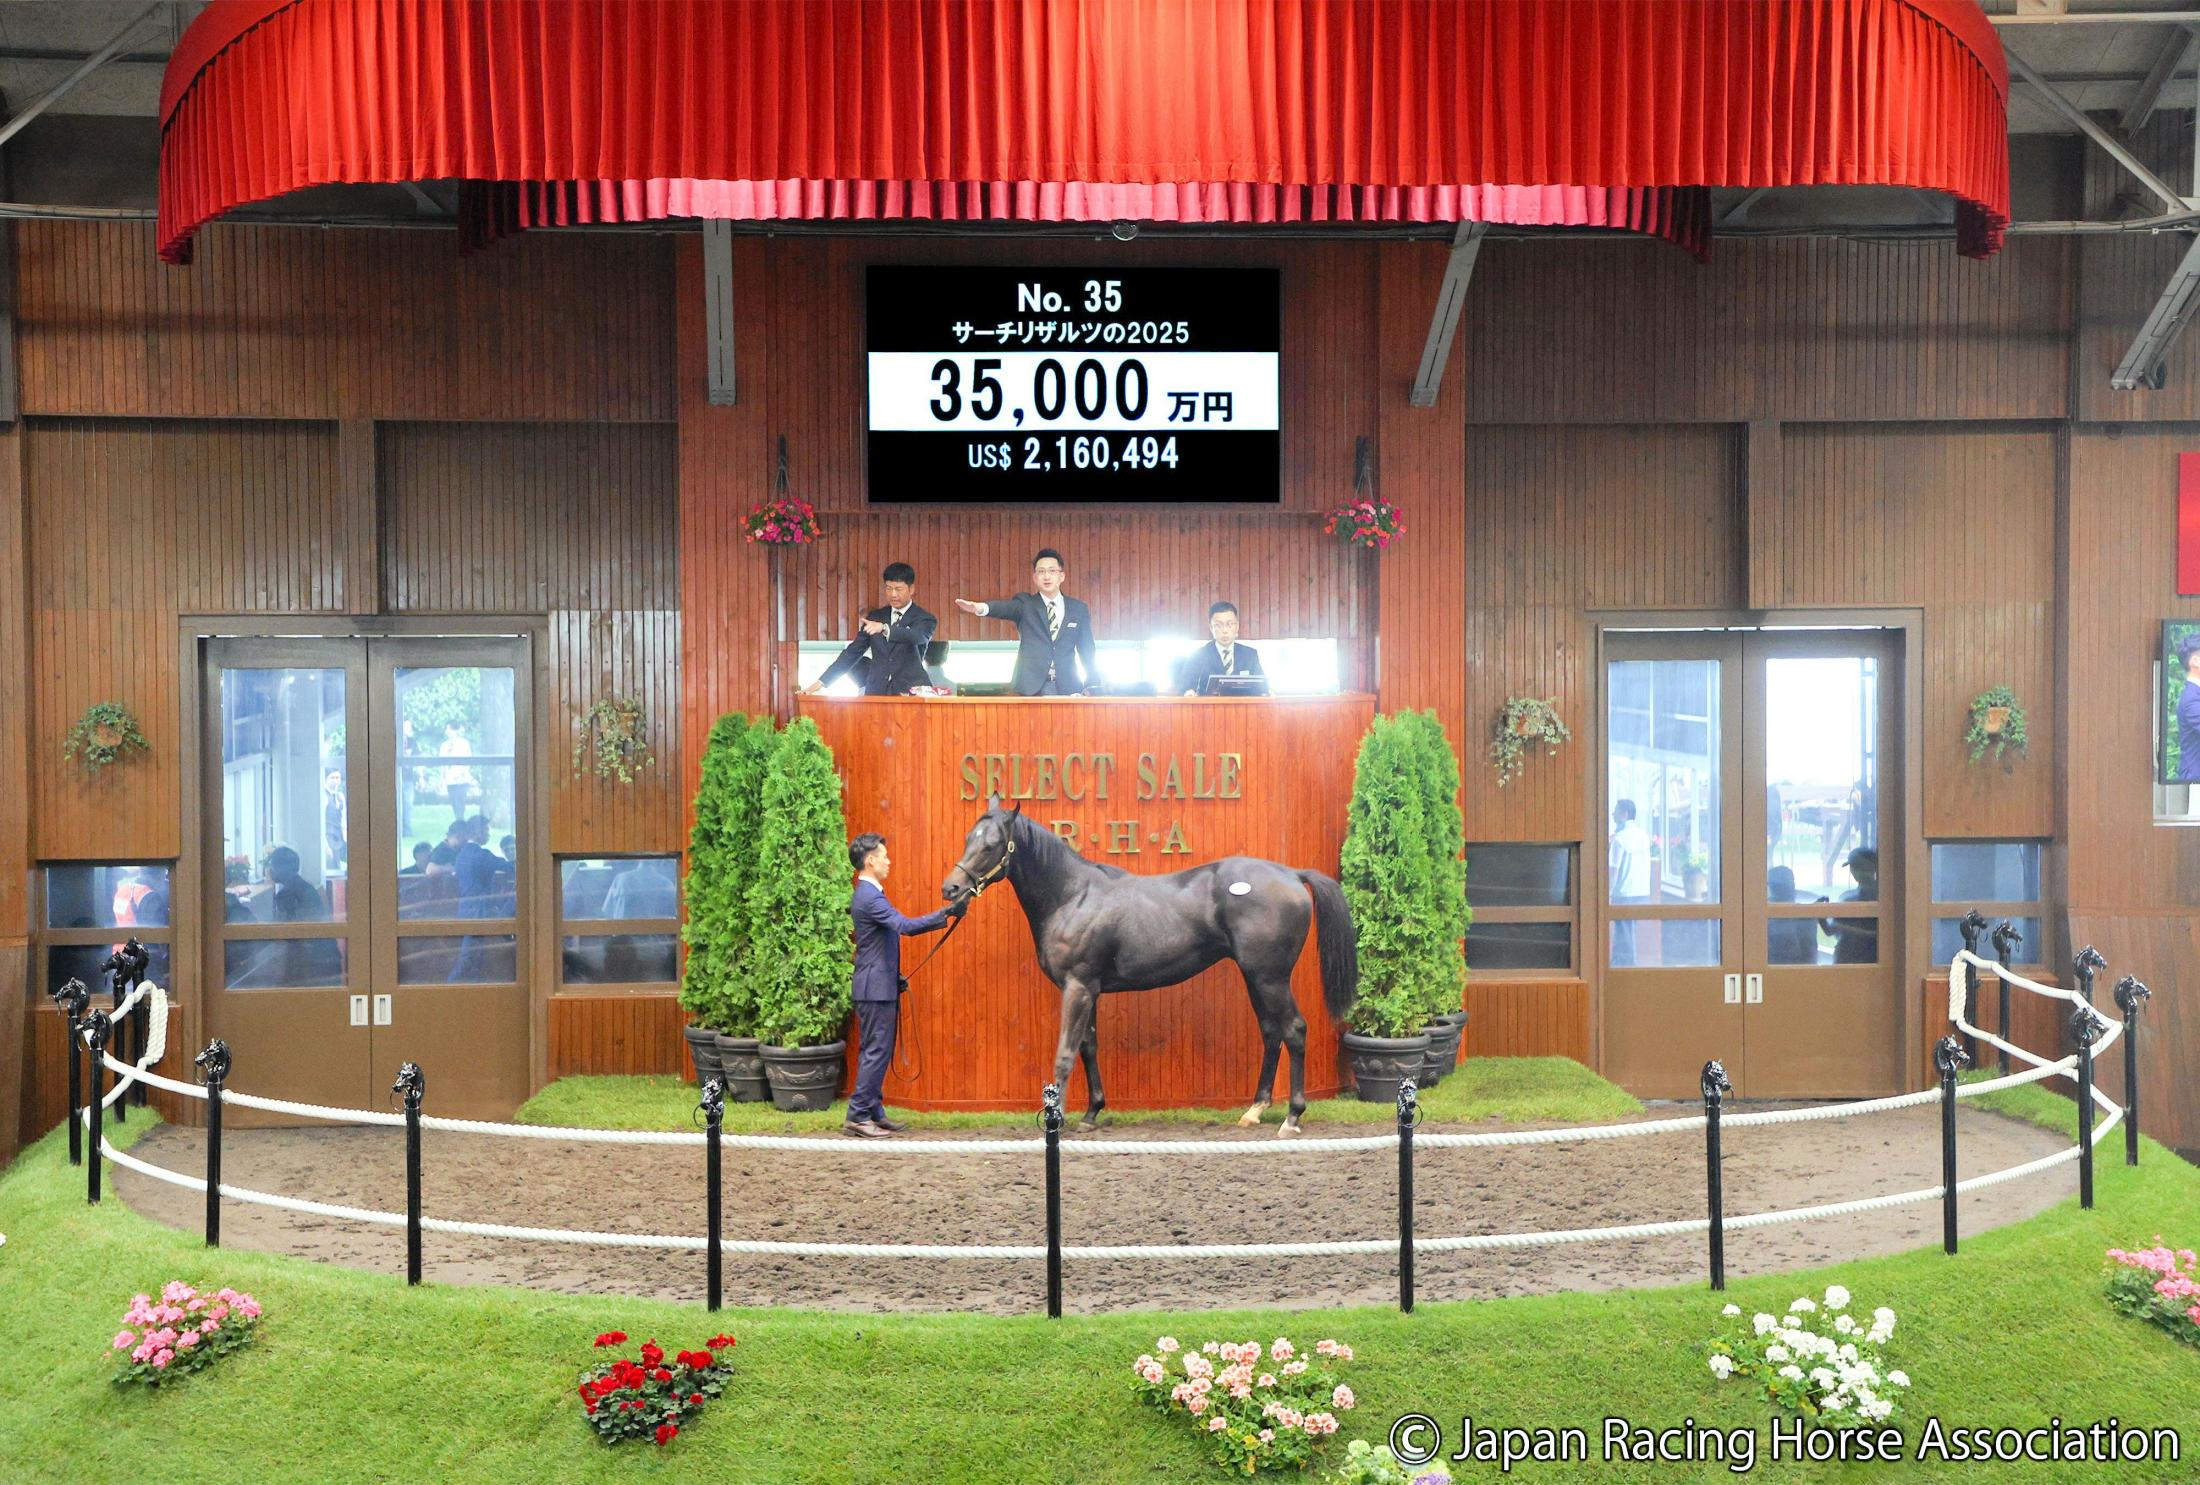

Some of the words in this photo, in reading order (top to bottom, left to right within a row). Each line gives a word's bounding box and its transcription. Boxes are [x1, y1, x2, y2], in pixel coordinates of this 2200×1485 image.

[1017, 283, 1071, 313] No.
[1084, 280, 1122, 313] 35
[952, 320, 1190, 345] サーチリザルツの2025
[929, 358, 1149, 427] 35,000
[1166, 391, 1234, 423] 万円
[967, 442, 1012, 470] US$
[1023, 436, 1180, 472] 2,160,494
[959, 752, 1116, 801] SELECT
[1136, 752, 1242, 800] SALE
